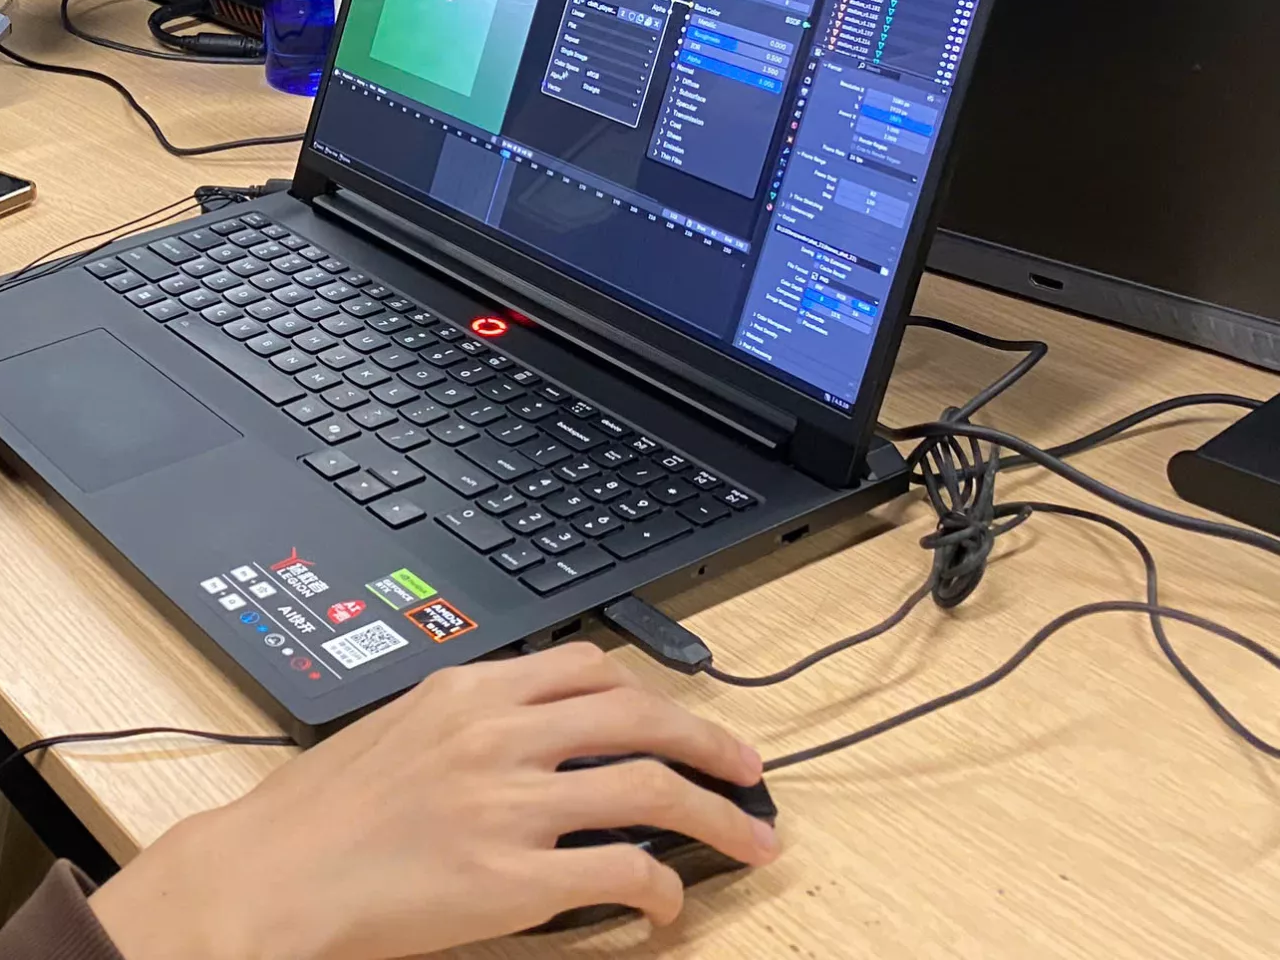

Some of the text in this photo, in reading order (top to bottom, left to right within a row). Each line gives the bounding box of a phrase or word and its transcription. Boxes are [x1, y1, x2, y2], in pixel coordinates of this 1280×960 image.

[556, 421, 590, 442] backspace
[556, 561, 577, 575] enter
[276, 568, 315, 598] LEGION
[374, 581, 392, 593] RTX
[382, 578, 415, 602] GEFORCE
